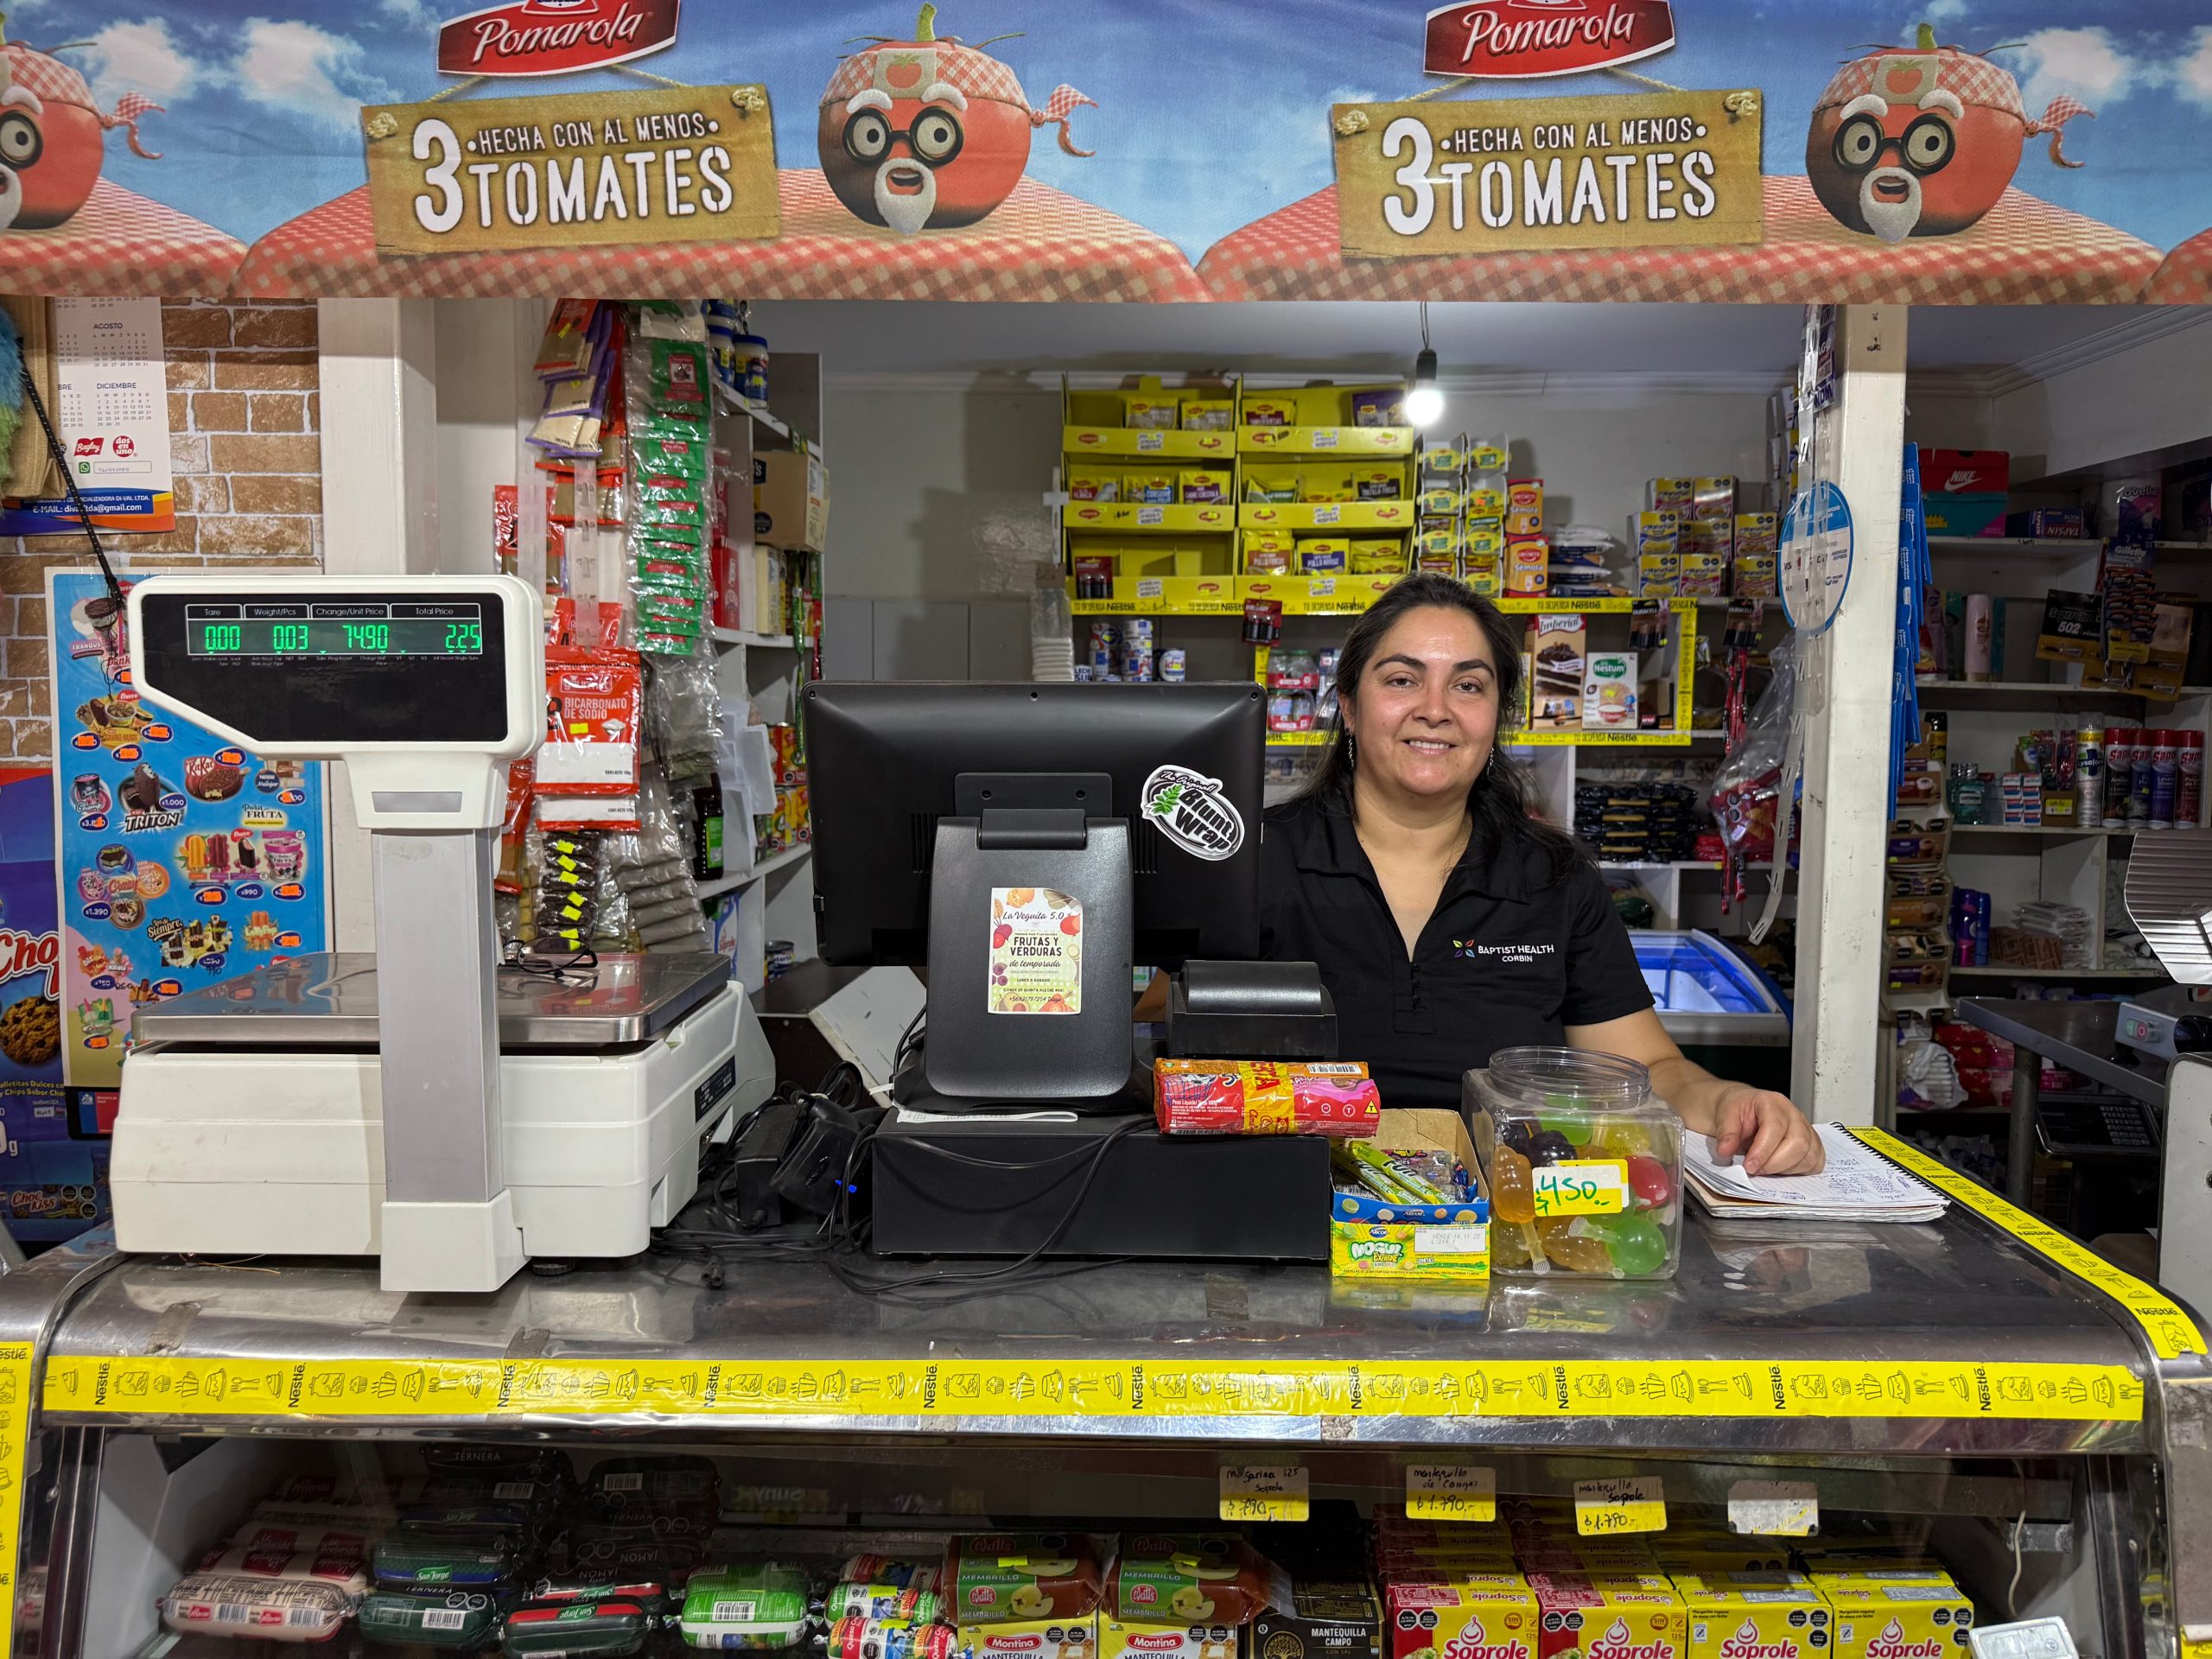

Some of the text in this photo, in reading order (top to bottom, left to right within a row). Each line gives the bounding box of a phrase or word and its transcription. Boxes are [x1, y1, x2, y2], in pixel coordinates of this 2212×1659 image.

[471, 10, 645, 65] Pomarola
[1459, 3, 1637, 65] Pomarola
[480, 111, 705, 155] HECHA CON AL MENOS
[1454, 117, 1692, 153] HECHA CON AL MENOS
[412, 118, 462, 233] 3
[1382, 117, 1434, 235] 3
[467, 146, 733, 228] TOMATES
[1440, 150, 1716, 231] TOMATES
[76, 442, 101, 453] Bagley
[116, 435, 130, 444] dos
[1950, 471, 1976, 483] NIKE
[254, 607, 296, 617] Weight/Pcs
[316, 607, 364, 616] Change/Unit
[1571, 600, 1601, 609] Nestlé
[1540, 616, 1580, 632] Imperial
[564, 697, 627, 709] BICARBONATO
[564, 709, 607, 720] DE SODIO
[1607, 733, 1637, 741] Nestlé
[188, 758, 214, 776] KitKat
[1160, 771, 1176, 781] The
[125, 814, 179, 832] TRITON
[1179, 789, 1235, 841] Blunt
[1175, 804, 1230, 849] Wrap
[1002, 912, 1065, 922] La Veguita 5.0
[1014, 937, 1058, 946] FRUTAS Y
[1478, 944, 1554, 955] BAPTIST HEALTH
[1010, 947, 1062, 957] VERDURAS
[1009, 959, 1061, 971] de temporada
[0, 1080, 29, 1089] alletitas
[9, 1141, 18, 1156] g
[12, 1191, 41, 1205] Choc
[1351, 1241, 1404, 1257] MOGUL
[2134, 1307, 2180, 1317] Nestlé
[0, 1348, 27, 1360] estlé
[95, 1361, 111, 1406] Nestlé
[289, 1362, 307, 1408] Nestlé
[497, 1363, 517, 1408] Nestlé
[704, 1363, 721, 1408] Nestlé
[923, 1363, 938, 1409] Nestlé
[1131, 1363, 1144, 1410] Nestlé
[1350, 1363, 1361, 1410] Nestlé
[1555, 1363, 1567, 1409] Nestlé
[1775, 1364, 1787, 1411] Nestlé
[1980, 1364, 1992, 1412] Nestlé
[454, 1451, 500, 1461] TERNERA
[417, 1568, 451, 1582] San Jorge
[1124, 1572, 1181, 1581] MEMBRILLO
[1311, 1628, 1366, 1637] MANTEQUILLA
[991, 1637, 1033, 1648] Montina
[1134, 1636, 1176, 1647] Montina
[1325, 1637, 1351, 1646] CAMPO
[1444, 1639, 1529, 1659] Soprole
[1589, 1640, 1673, 1659] Soprole
[1720, 1639, 1798, 1659] Soprole
[1866, 1638, 1942, 1659] Soprole
